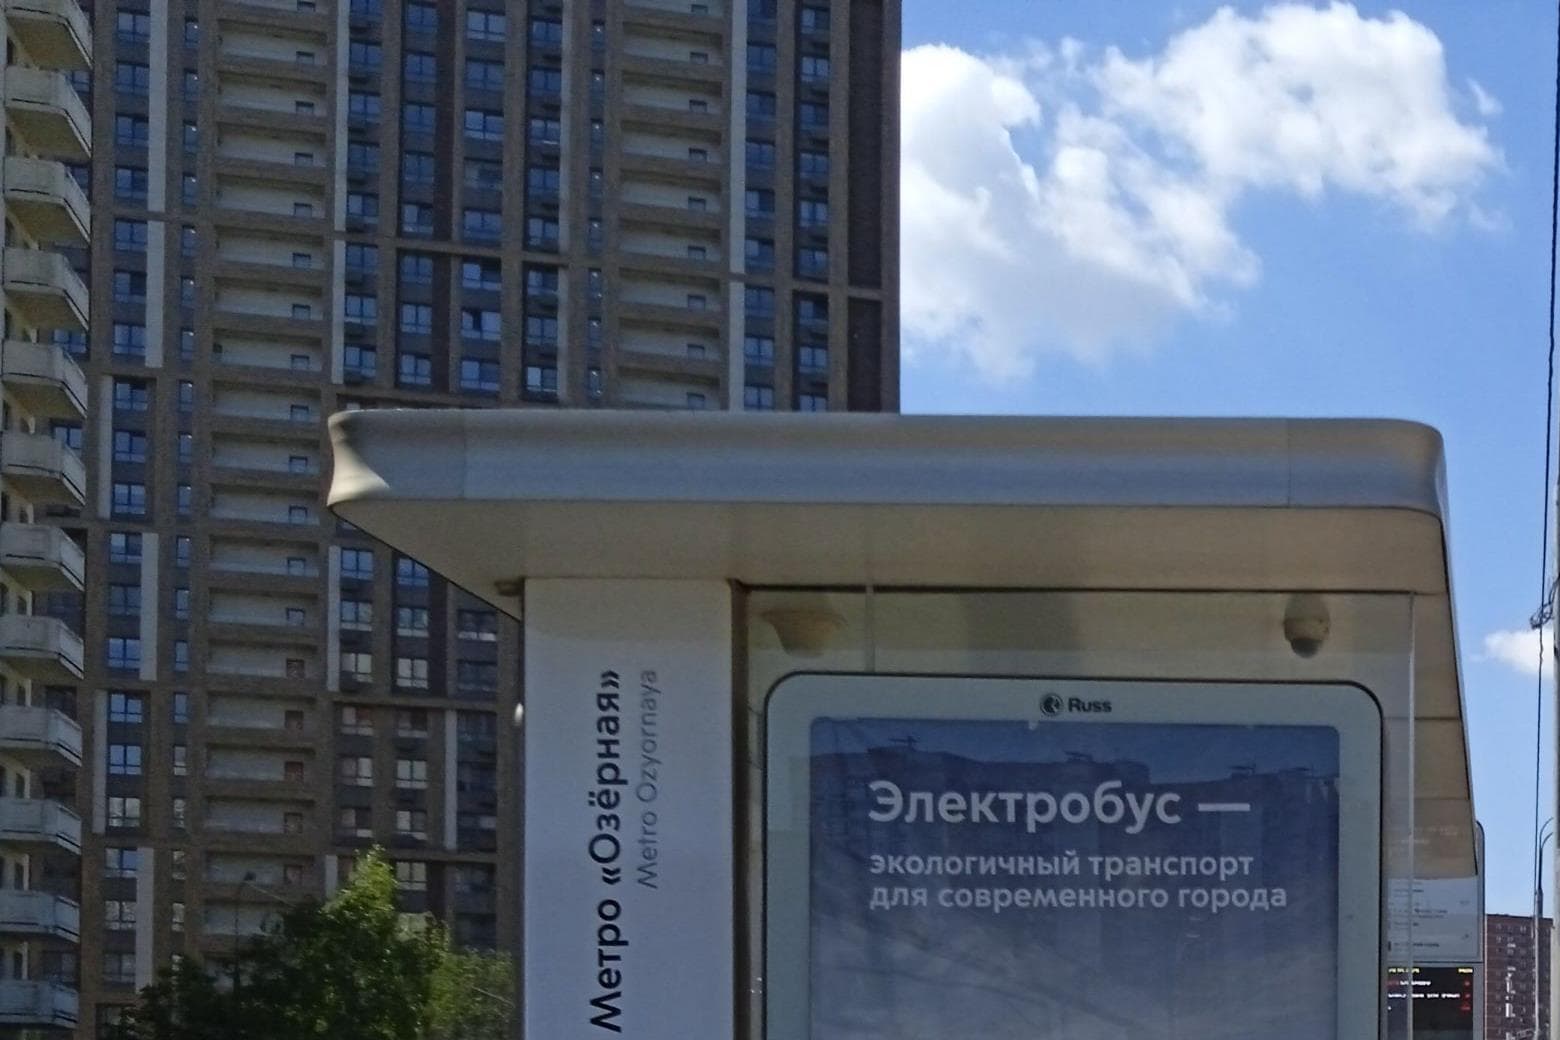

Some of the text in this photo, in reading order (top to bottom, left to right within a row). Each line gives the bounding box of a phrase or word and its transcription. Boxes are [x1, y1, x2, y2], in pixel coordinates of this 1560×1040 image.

[1067, 697, 1113, 713] Russ
[635, 669, 663, 889] Metro Ozyornaya
[867, 780, 1182, 834] Электробус
[587, 669, 629, 1034] Метро «Озёрная»
[868, 848, 1254, 887] экологичный транспорт
[868, 882, 1288, 912] для современного города
